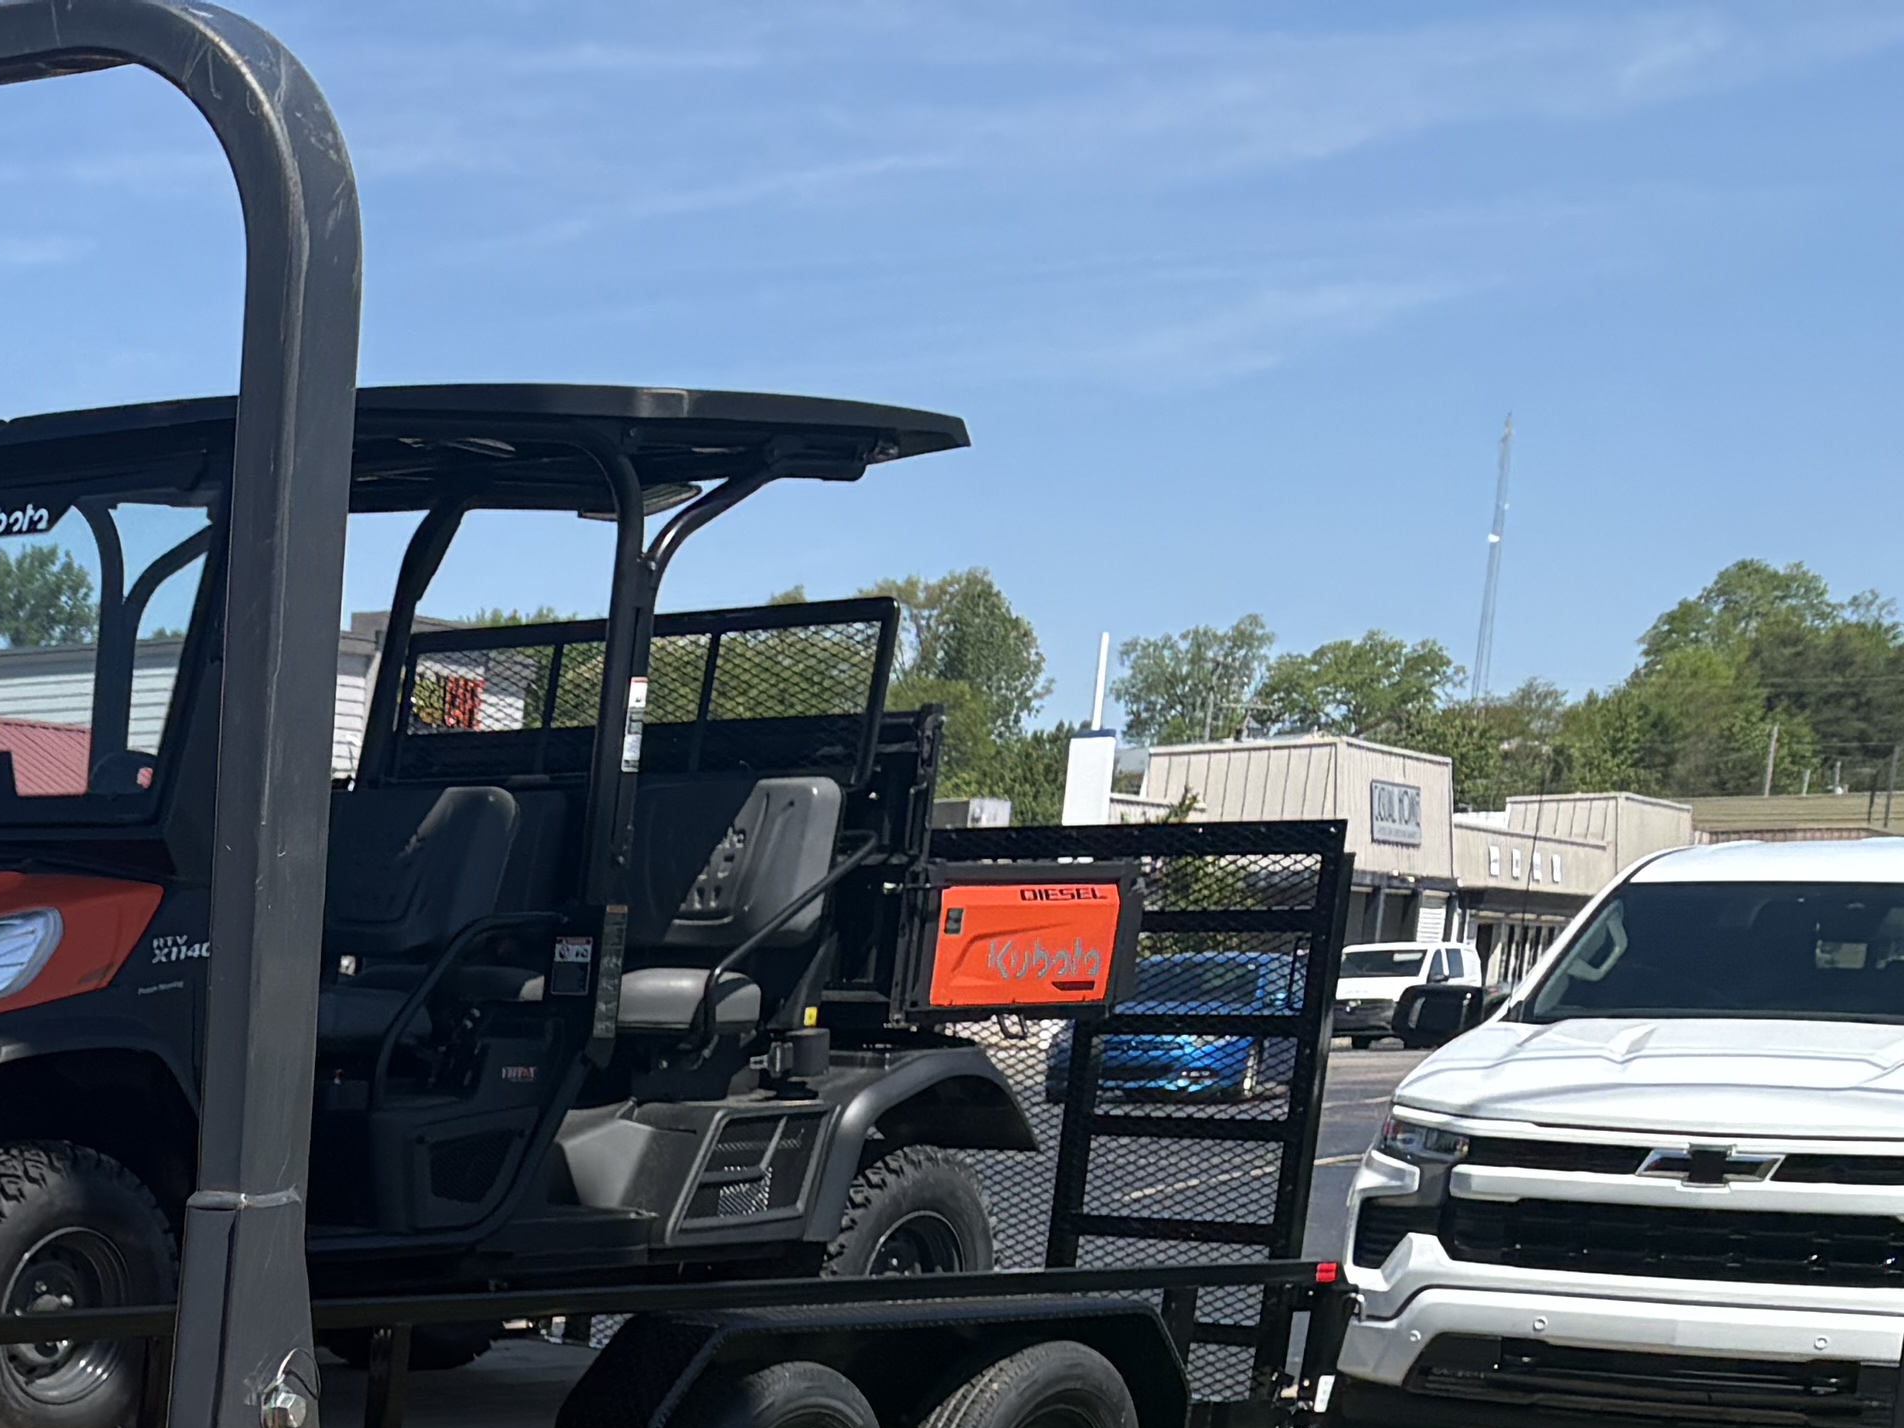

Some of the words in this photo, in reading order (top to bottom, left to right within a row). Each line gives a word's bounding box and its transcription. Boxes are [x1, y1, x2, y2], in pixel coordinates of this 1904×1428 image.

[1020, 887, 1108, 901] DIESEL
[152, 934, 188, 948] RTV
[987, 937, 1101, 980] Kubota
